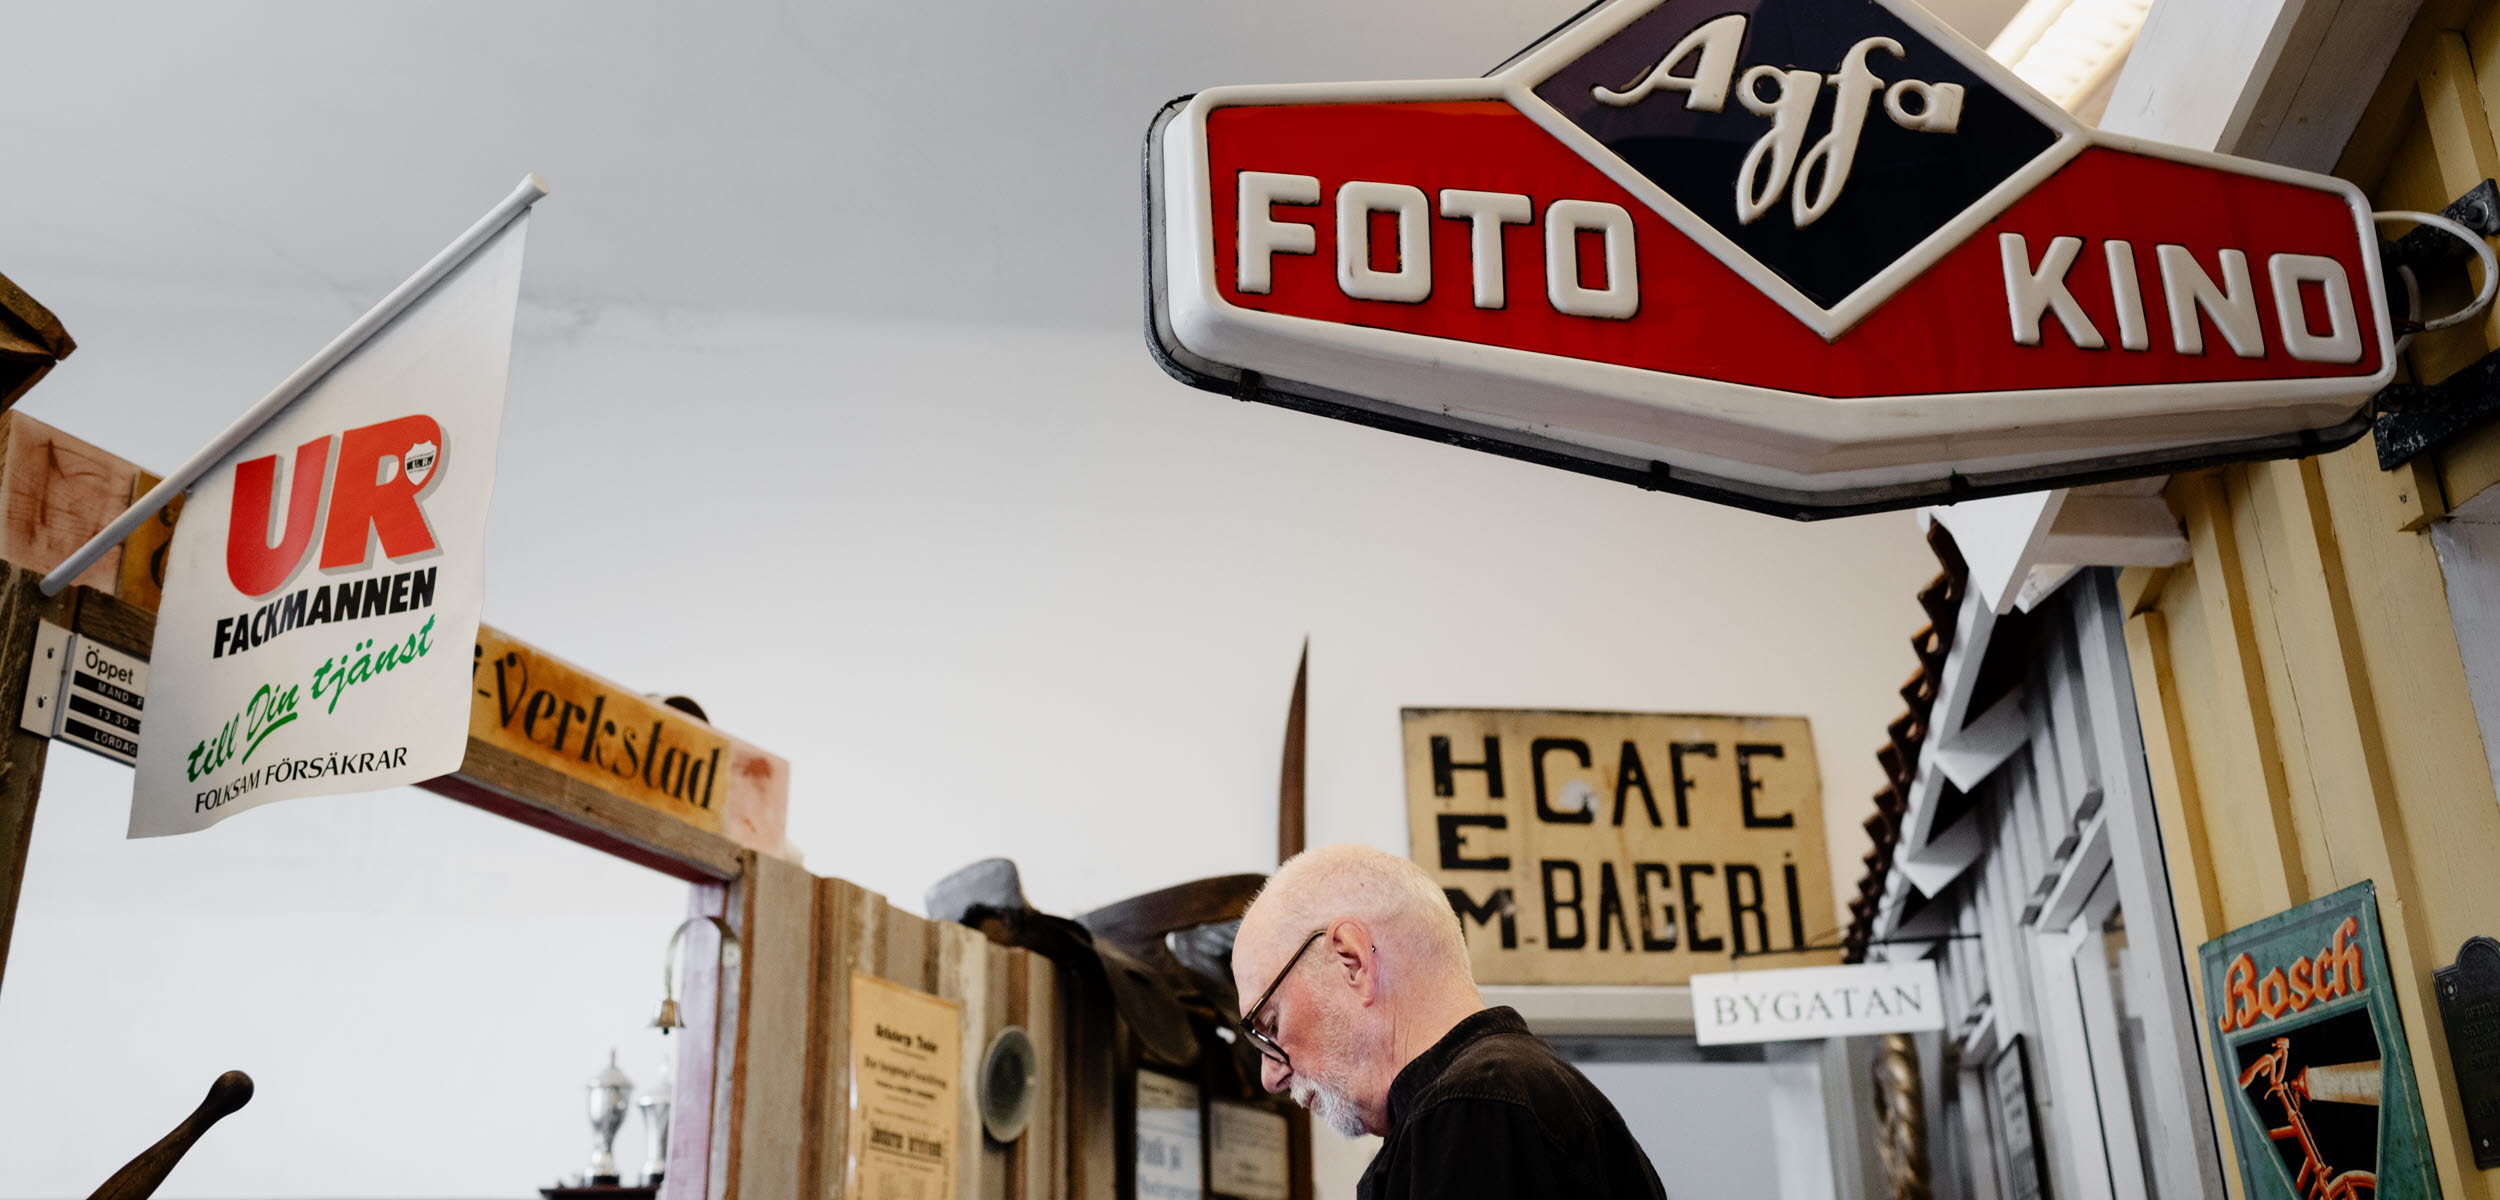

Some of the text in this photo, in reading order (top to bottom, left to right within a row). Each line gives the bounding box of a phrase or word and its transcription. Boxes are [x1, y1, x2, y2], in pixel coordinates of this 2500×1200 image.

[1592, 13, 1966, 229] Agfa
[1237, 170, 1640, 321] FOTO
[1999, 232, 2363, 365] KINO
[226, 414, 445, 599] UR
[85, 645, 134, 685] Öppet
[213, 566, 437, 659] FACKMANNEN
[187, 613, 435, 783] till Din tjänst
[195, 747, 407, 813] FOLKSAM FÖRSÄKRAR
[1530, 737, 1795, 828] CAFE
[1713, 984, 1923, 1026] BYGATAN
[2219, 916, 2365, 1033] Bosch
